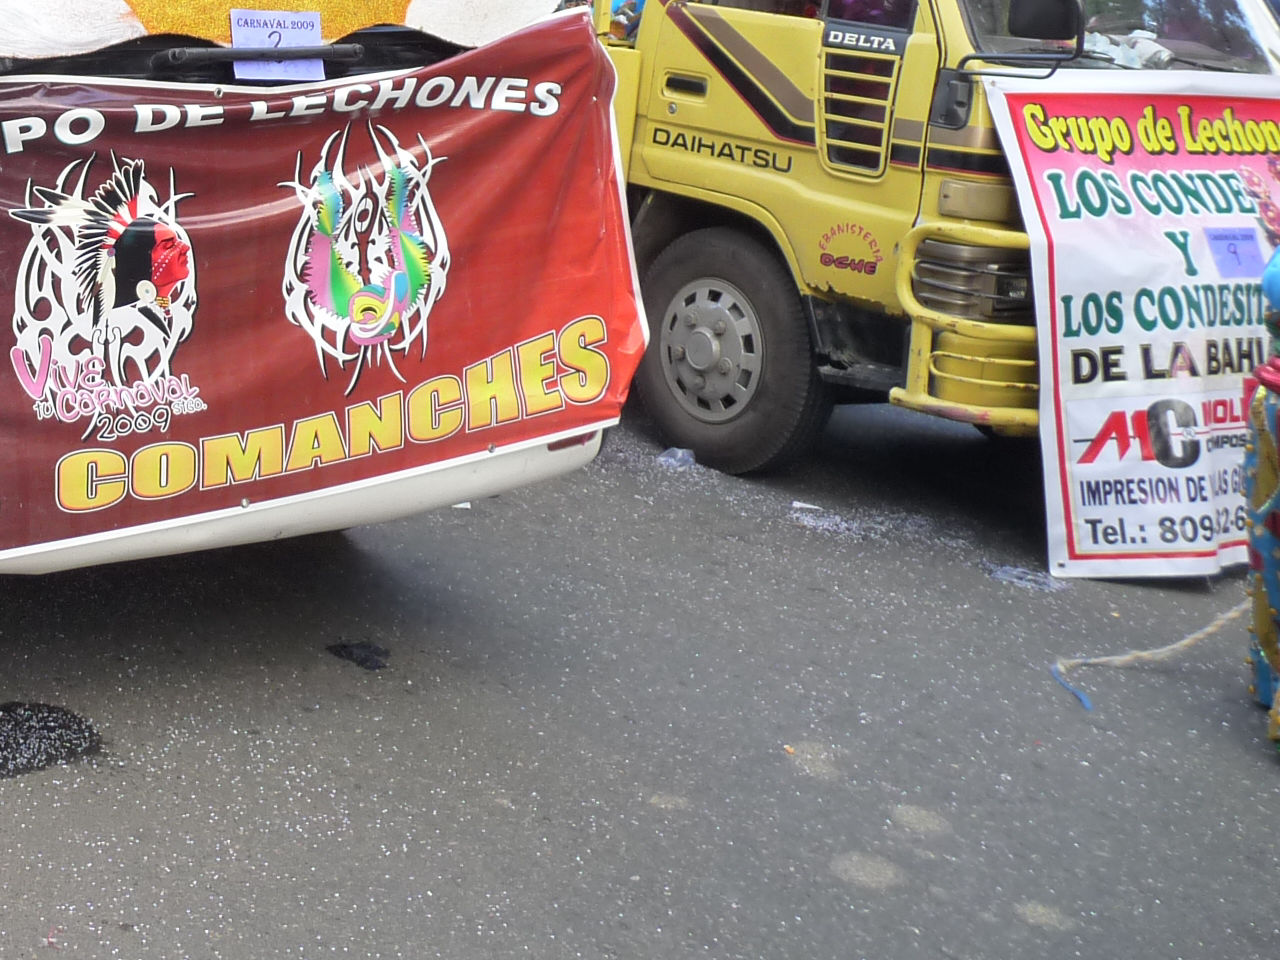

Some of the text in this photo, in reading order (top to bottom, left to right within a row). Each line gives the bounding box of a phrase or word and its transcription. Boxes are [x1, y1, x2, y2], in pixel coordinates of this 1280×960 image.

[237, 17, 315, 31] CARNAVAL 2009
[828, 30, 896, 50] DELTA
[133, 104, 225, 133] DE
[249, 76, 563, 117] LECHONES
[653, 127, 793, 173] DAIHATSU
[1022, 103, 1280, 164] Grupo de Lechon
[1046, 169, 1133, 220] LOS
[1163, 230, 1199, 277] Y
[1227, 242, 1241, 266] 9
[1060, 290, 1124, 338] LOS
[1070, 345, 1128, 385] DE
[1139, 341, 1201, 380] LA
[55, 315, 611, 513] COMANCHES
[96, 406, 171, 441] 2009
[1080, 478, 1182, 507] IMPRESION
[1186, 476, 1208, 503] DE
[1085, 517, 1148, 545] Tel.:
